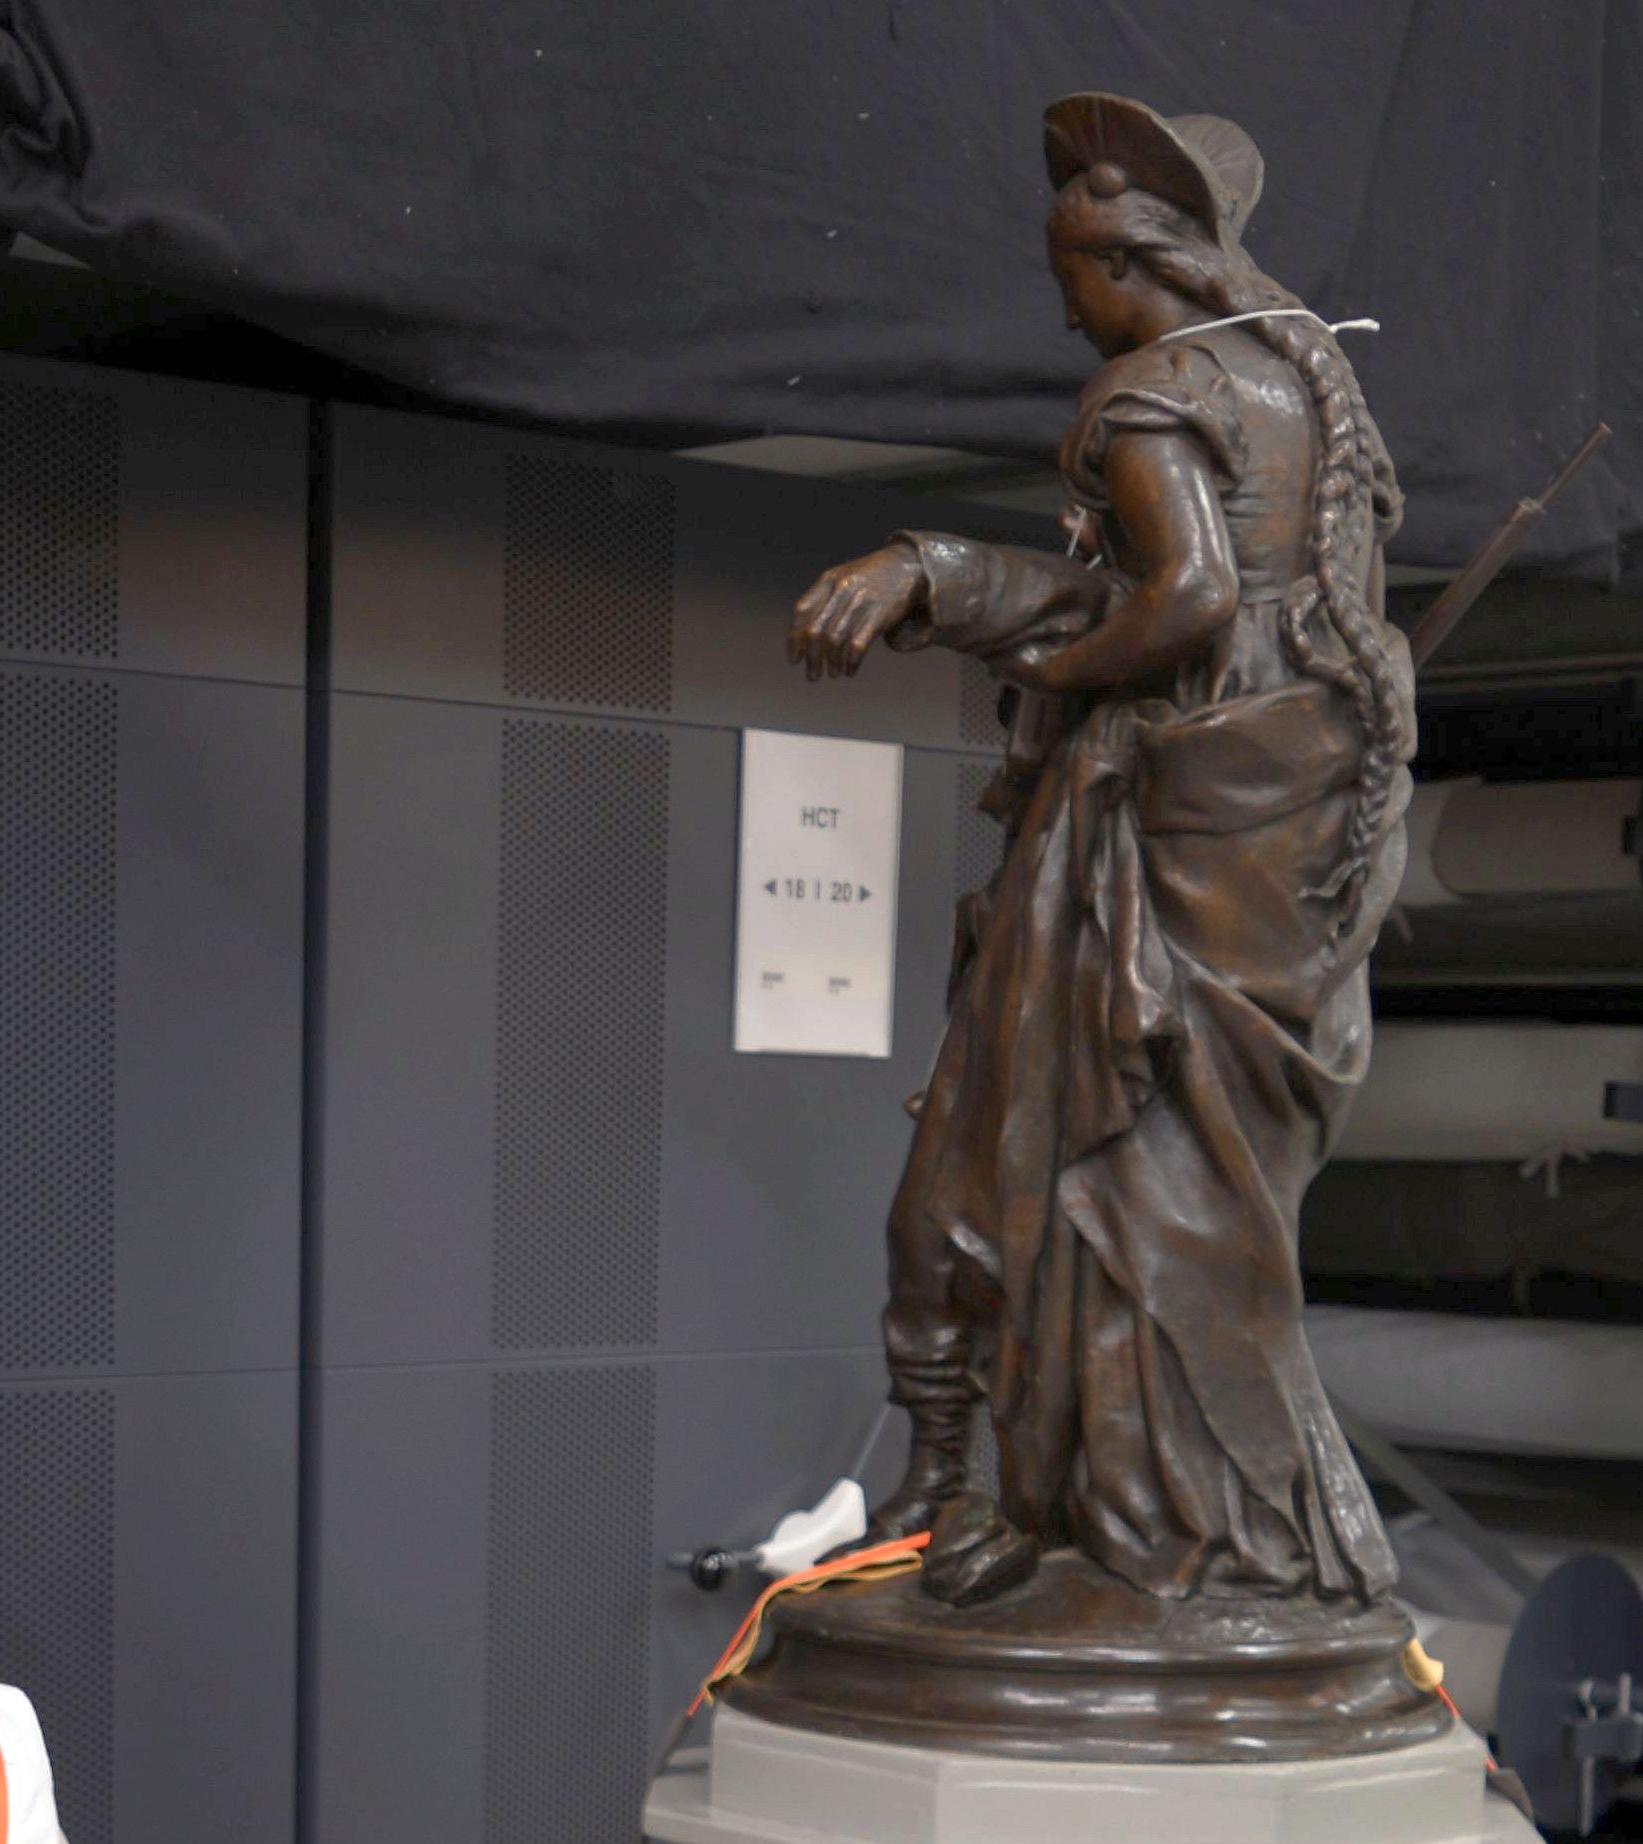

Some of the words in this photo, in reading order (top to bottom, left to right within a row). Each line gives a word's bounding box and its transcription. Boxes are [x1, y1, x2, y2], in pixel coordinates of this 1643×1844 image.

[801, 807, 840, 829] HCT
[784, 878, 806, 898] 18
[831, 881, 853, 902] 20
